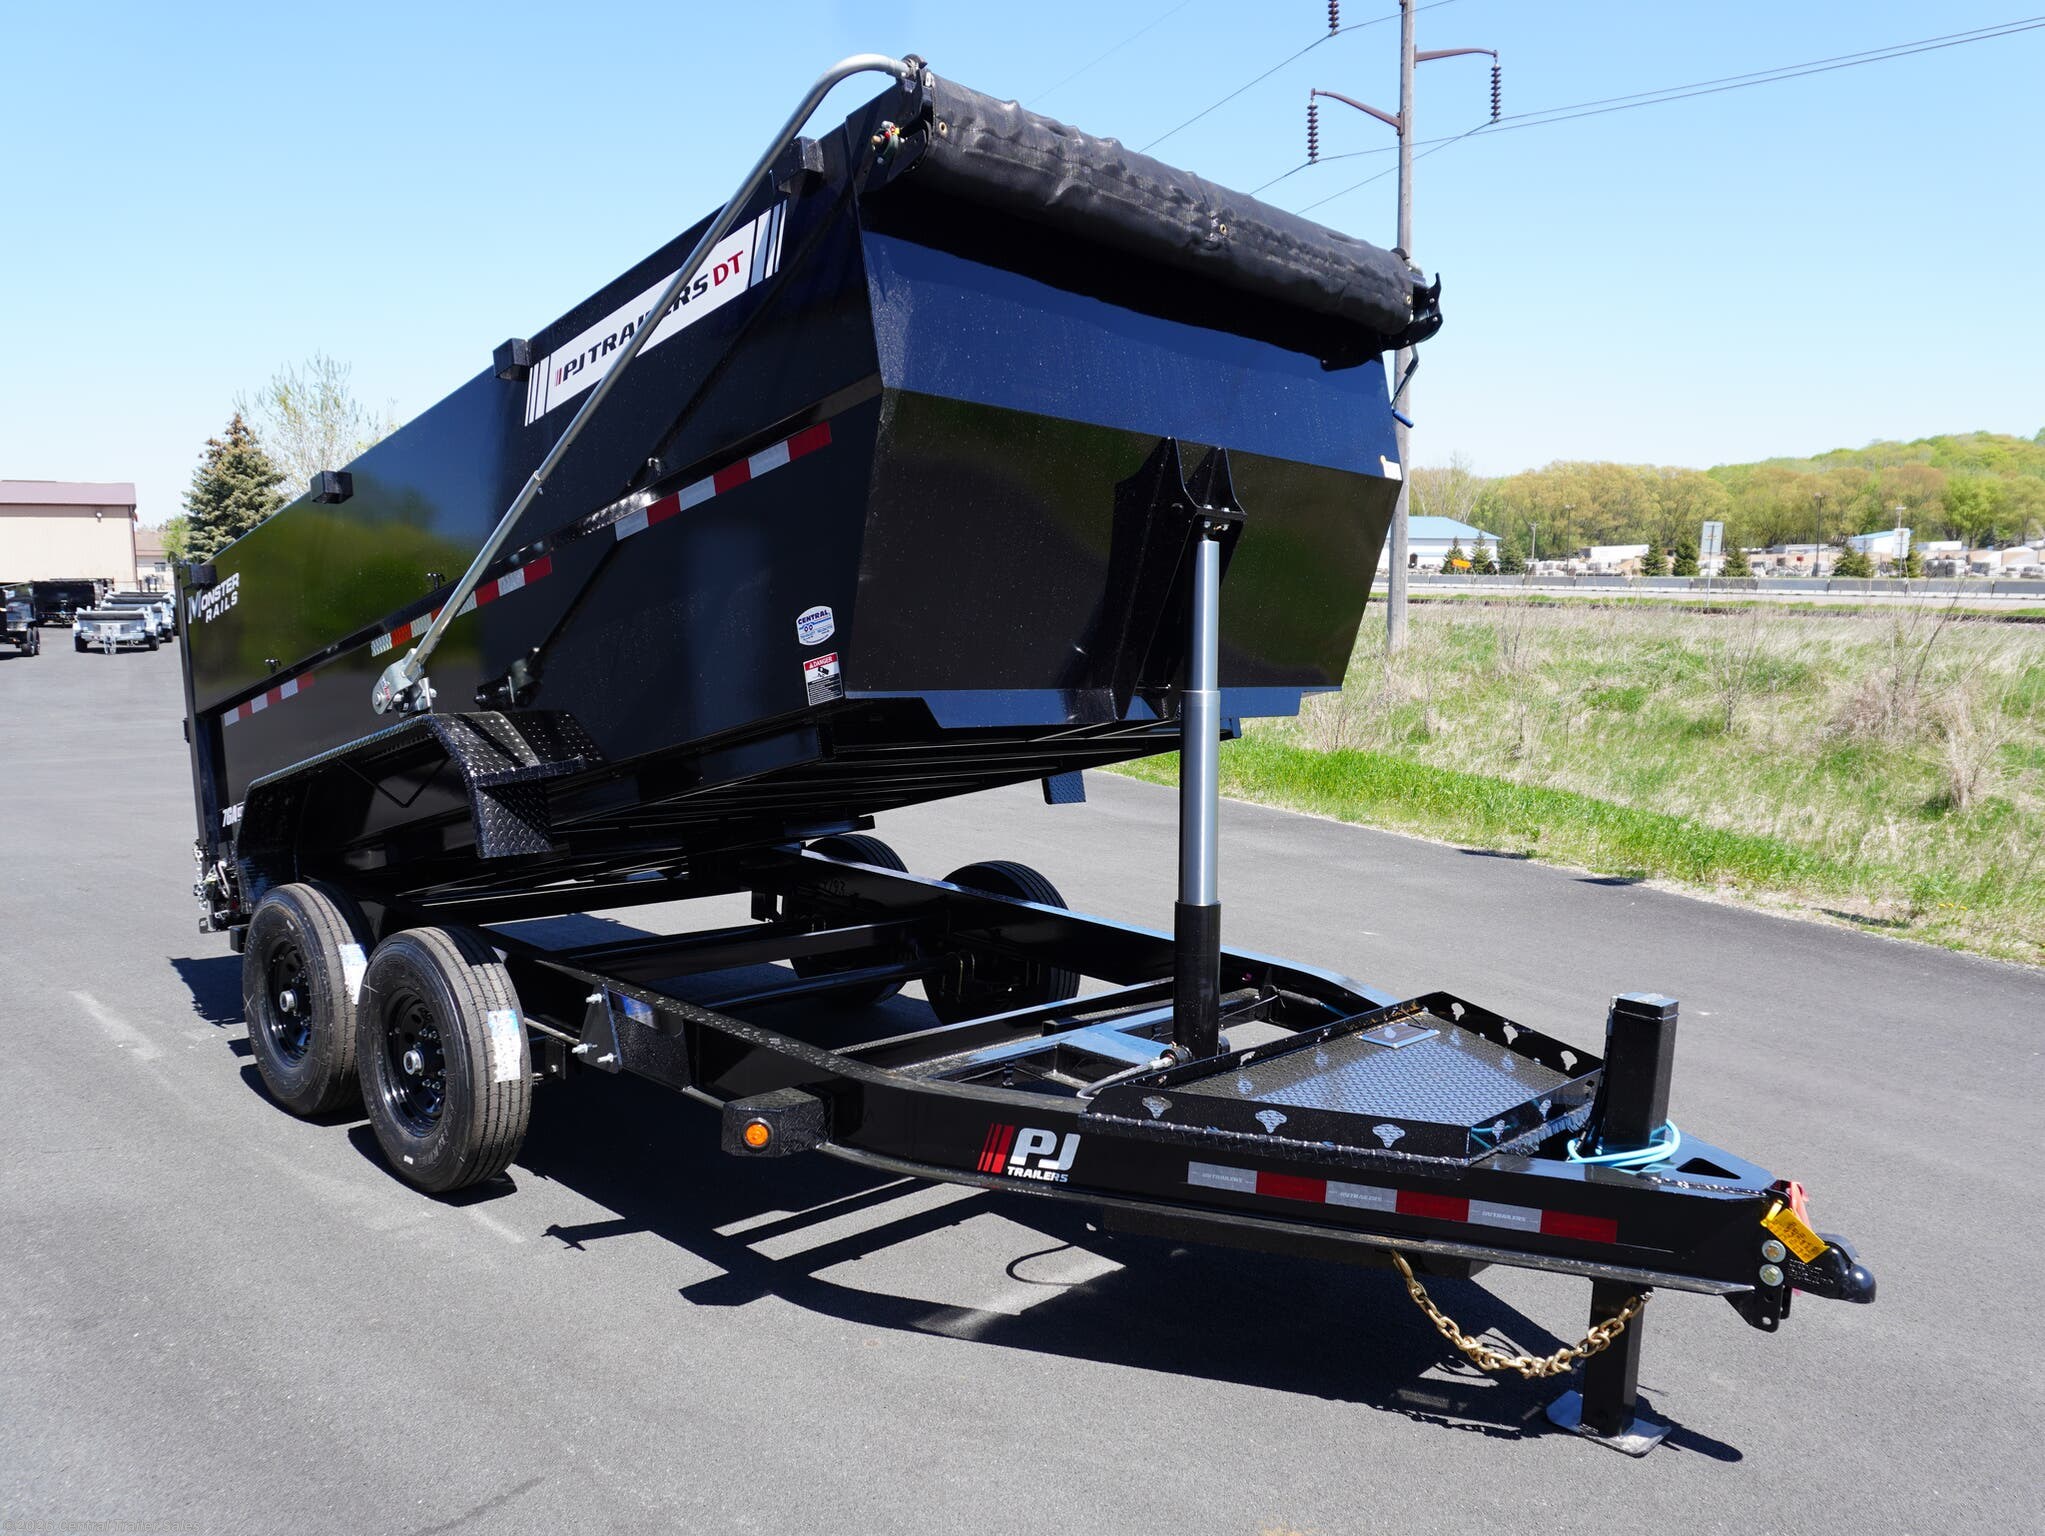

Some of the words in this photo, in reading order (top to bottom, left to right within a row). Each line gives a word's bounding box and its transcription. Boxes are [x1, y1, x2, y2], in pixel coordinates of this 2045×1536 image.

[562, 354, 585, 382] PJ
[588, 273, 708, 364] TRAIRS
[712, 250, 744, 287] DT
[205, 590, 238, 623] RAILS
[798, 609, 829, 625] CENTRAL
[813, 655, 833, 668] DANGER
[1009, 1128, 1081, 1171] PJ
[1007, 1165, 1069, 1183] TRAILERS
